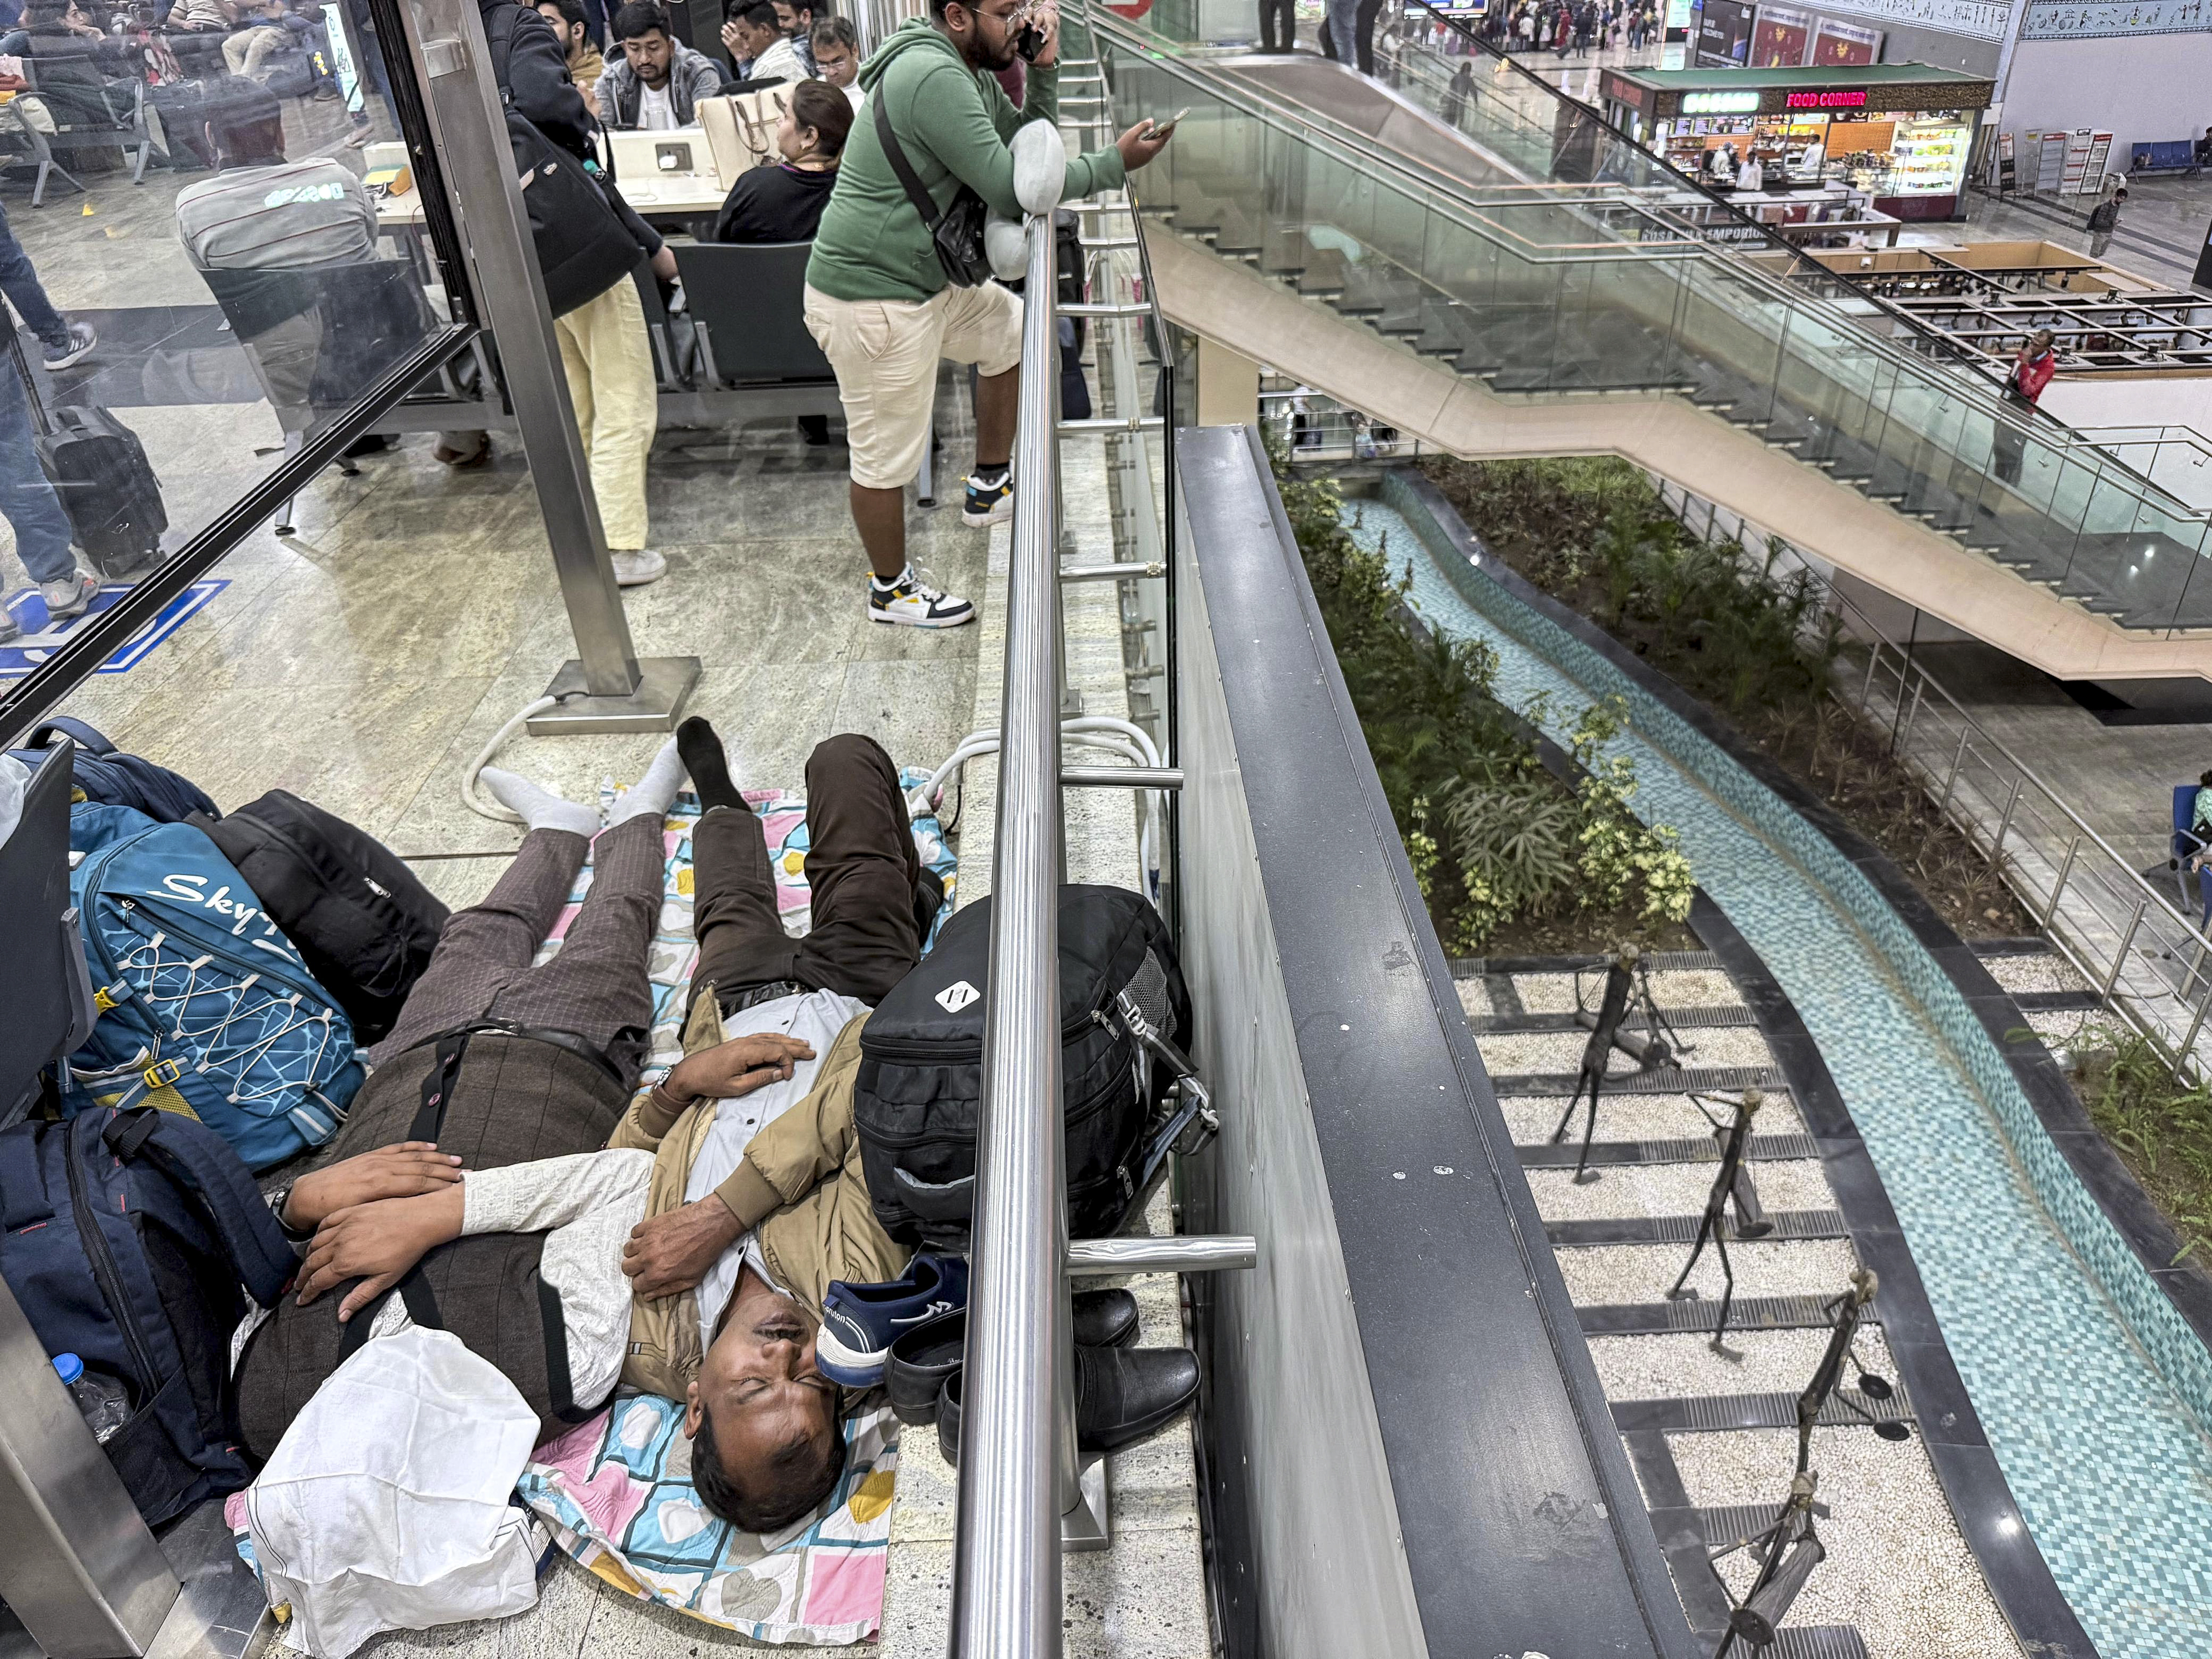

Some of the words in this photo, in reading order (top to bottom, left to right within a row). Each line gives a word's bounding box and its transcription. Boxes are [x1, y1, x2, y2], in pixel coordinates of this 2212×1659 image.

[1787, 93, 1818, 107] FOOD
[1820, 92, 1866, 106] CORNER
[1706, 228, 1769, 240] EMPORIU
